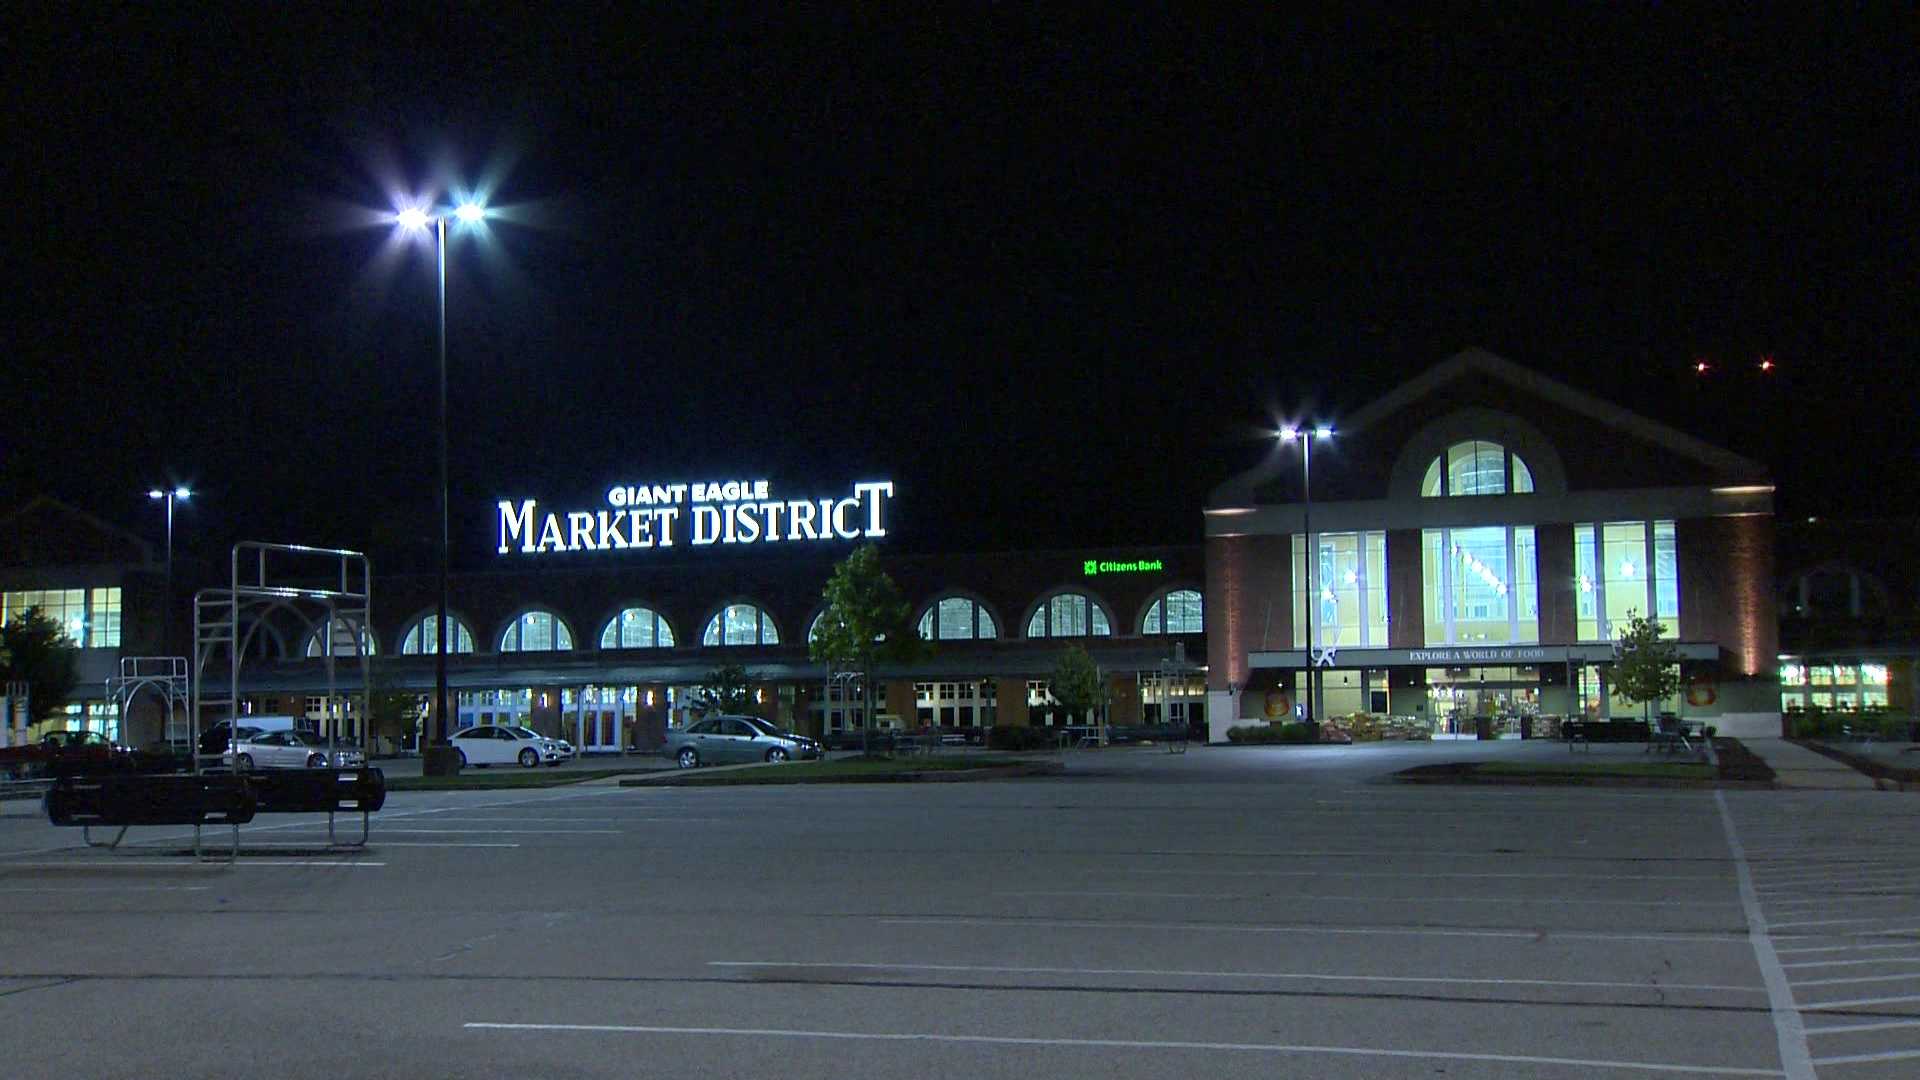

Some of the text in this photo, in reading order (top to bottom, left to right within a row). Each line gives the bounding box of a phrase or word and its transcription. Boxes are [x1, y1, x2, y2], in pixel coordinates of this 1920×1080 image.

[608, 481, 769, 506] GIANT EAGLE
[498, 481, 893, 554] MARKET DISTRICT
[1099, 559, 1162, 572] Citizens Bank
[1409, 649, 1544, 661] EXPLORE A WORLD OF FOOD
